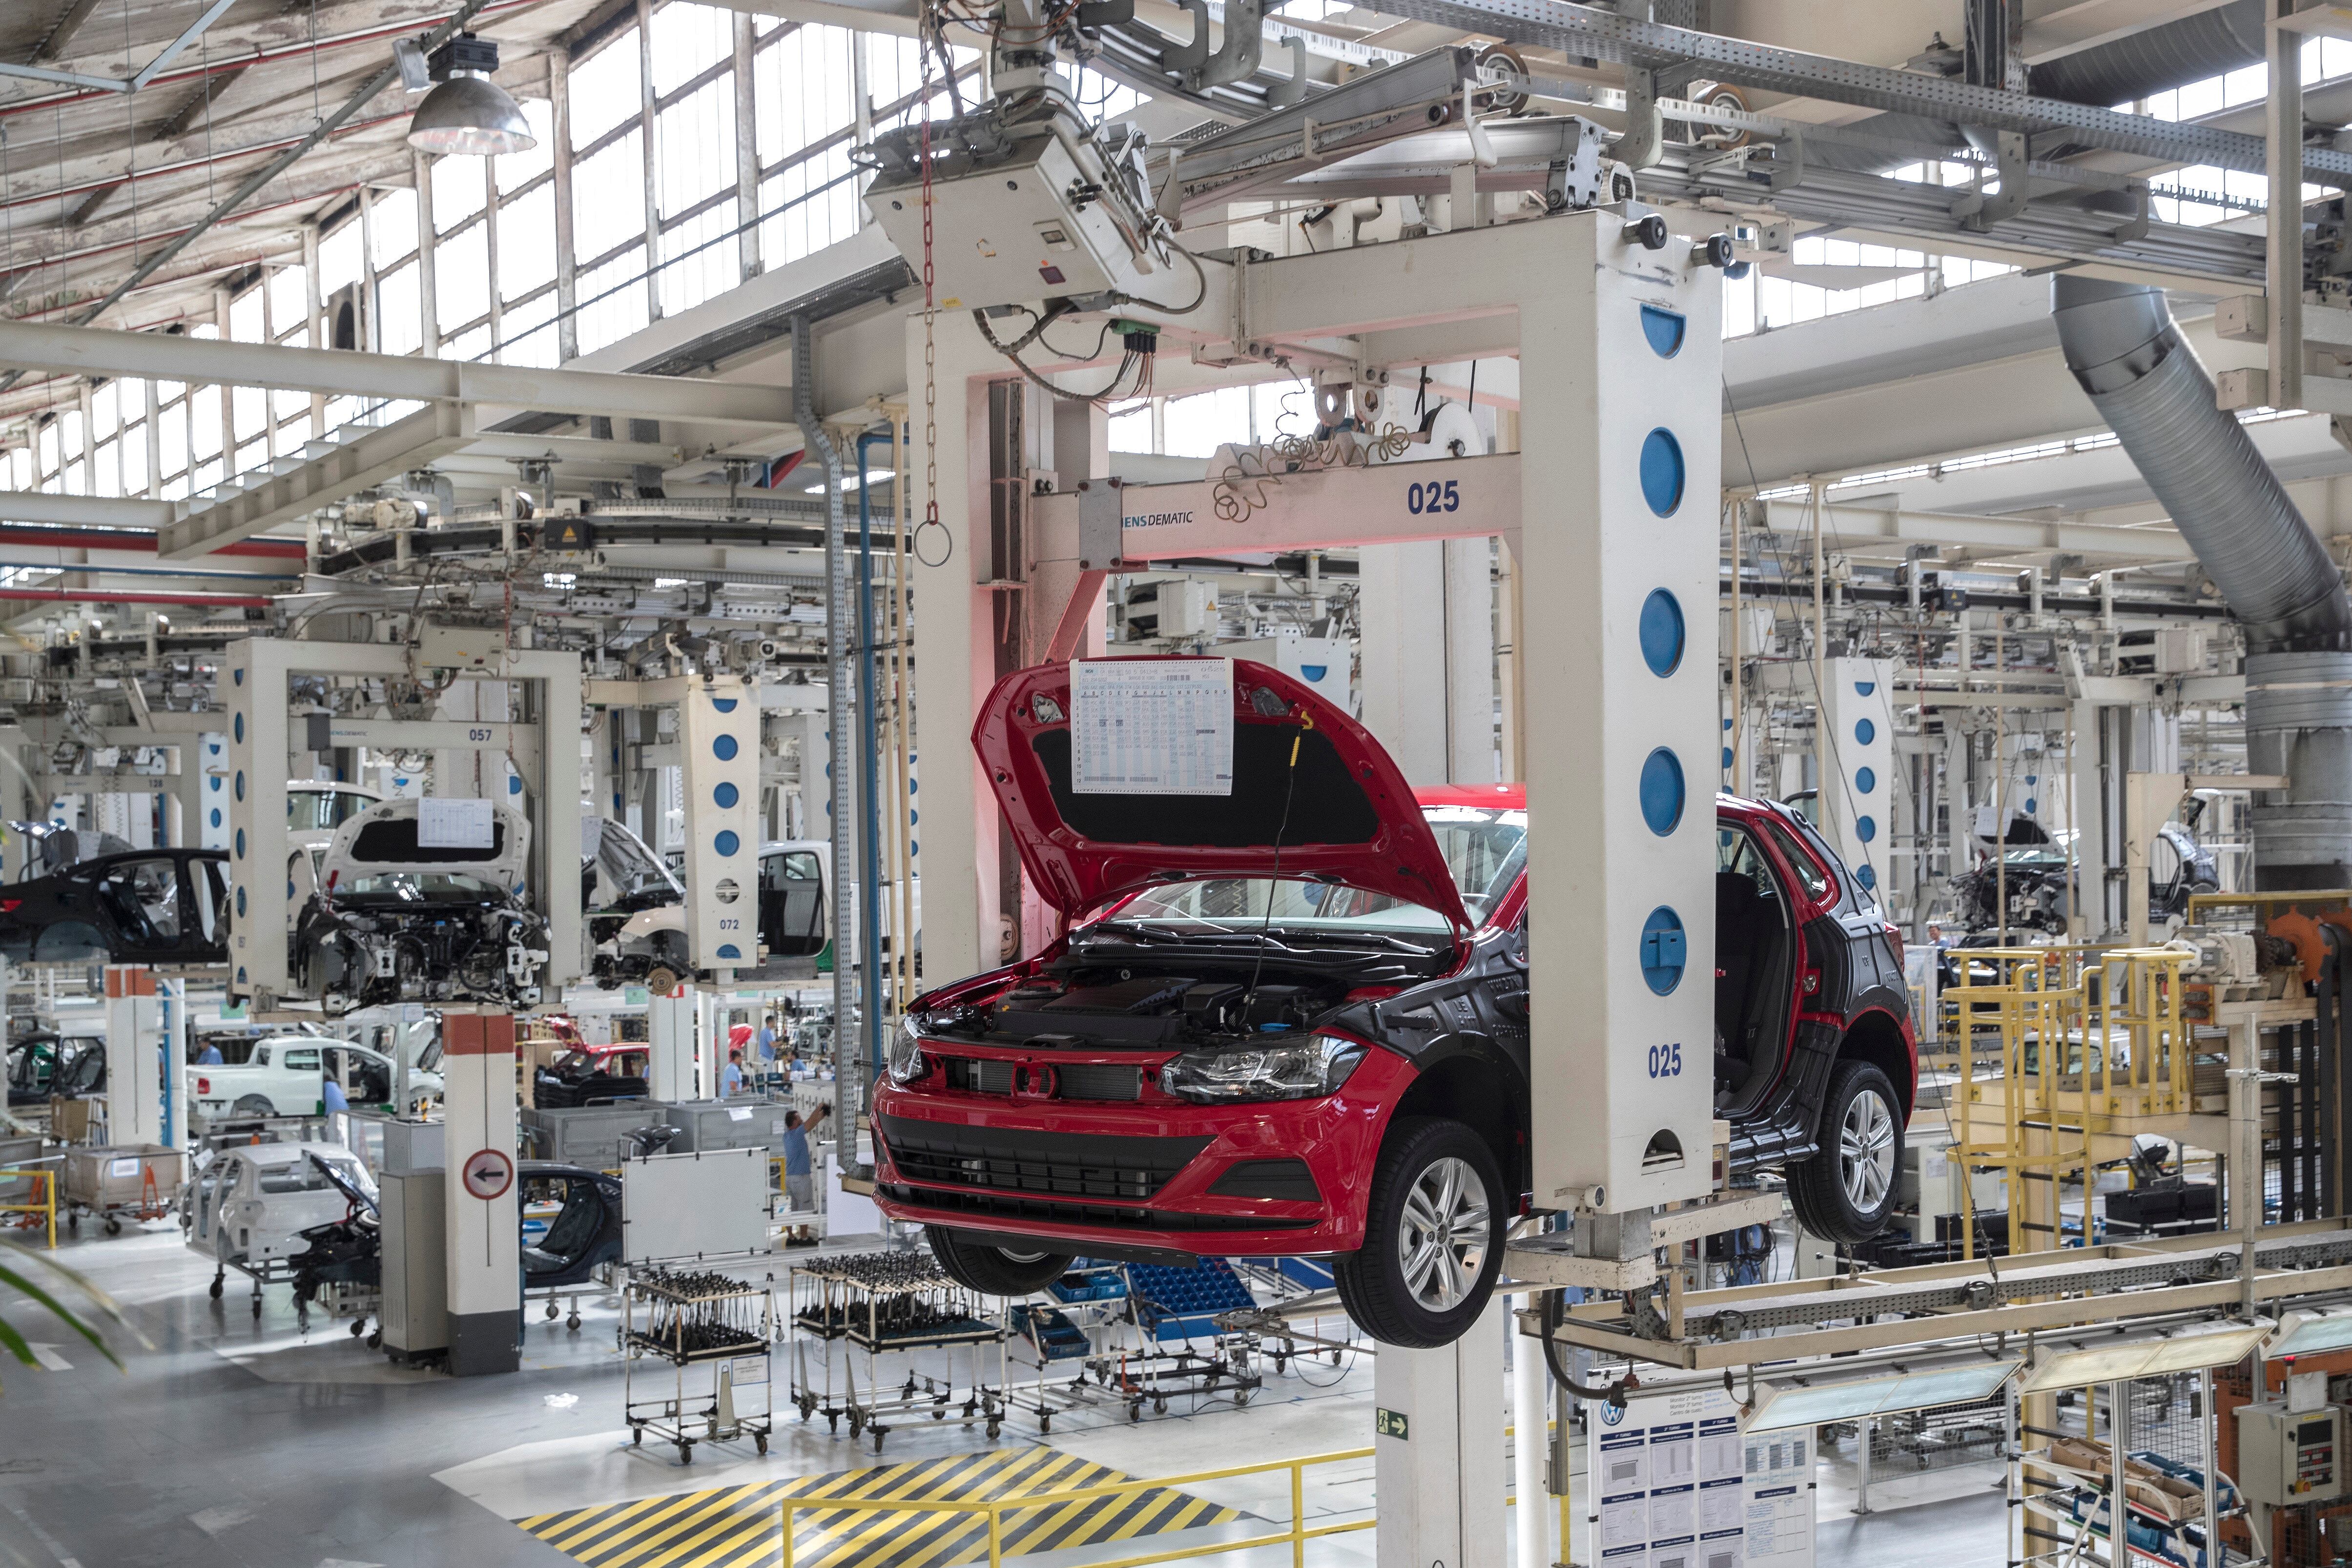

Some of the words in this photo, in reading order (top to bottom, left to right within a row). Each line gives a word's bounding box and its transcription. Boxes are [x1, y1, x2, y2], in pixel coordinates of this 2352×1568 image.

[1408, 480, 1460, 515] 025
[470, 729, 492, 742] 057
[720, 920, 740, 930] 072
[1649, 1043, 1682, 1079] 025
